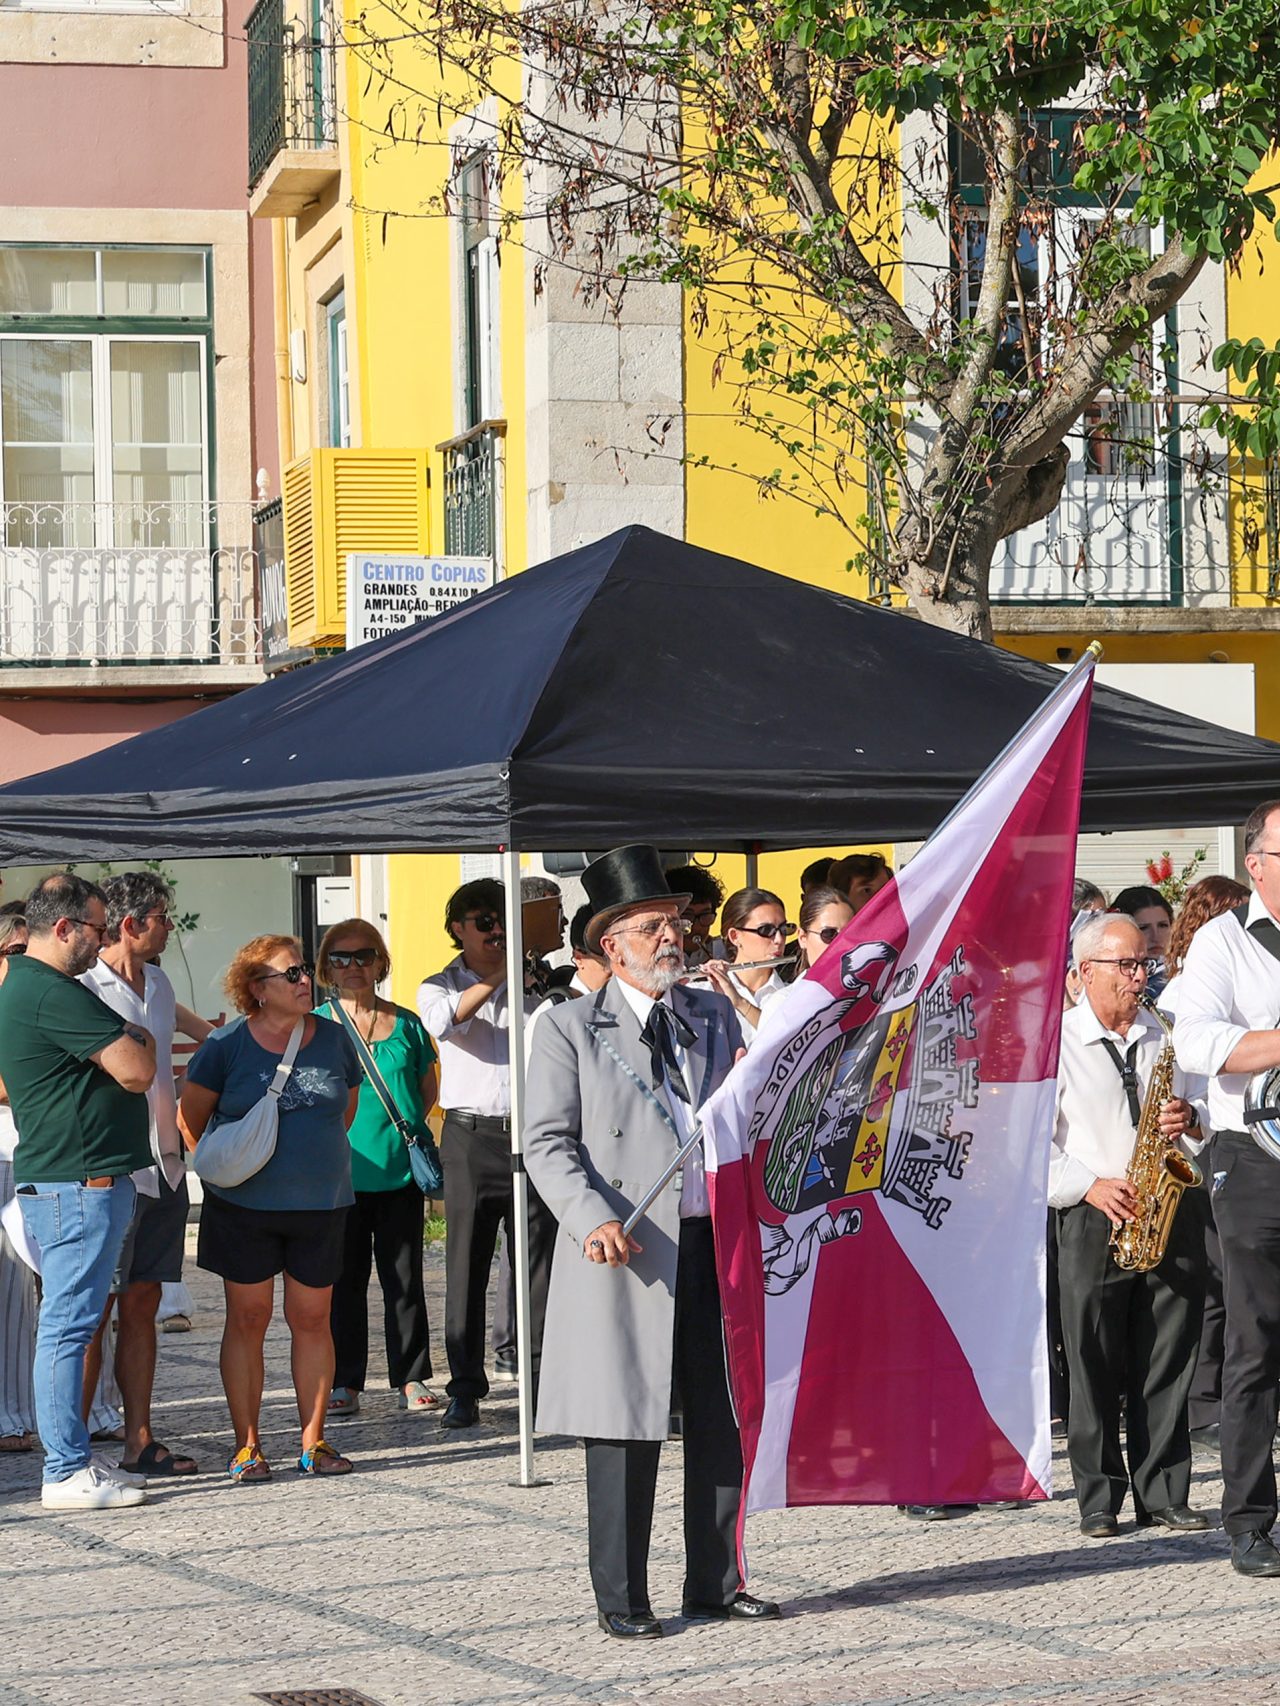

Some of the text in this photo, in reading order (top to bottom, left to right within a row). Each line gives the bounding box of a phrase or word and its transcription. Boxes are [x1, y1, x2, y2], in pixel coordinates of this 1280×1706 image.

[363, 561, 486, 583] CENTRO COPIAS
[364, 583, 417, 596] GRANDES
[364, 597, 462, 614] AMPLIAÇÃO-RED
[370, 614, 406, 624] A4-150
[766, 1020, 822, 1096] CIDADE
